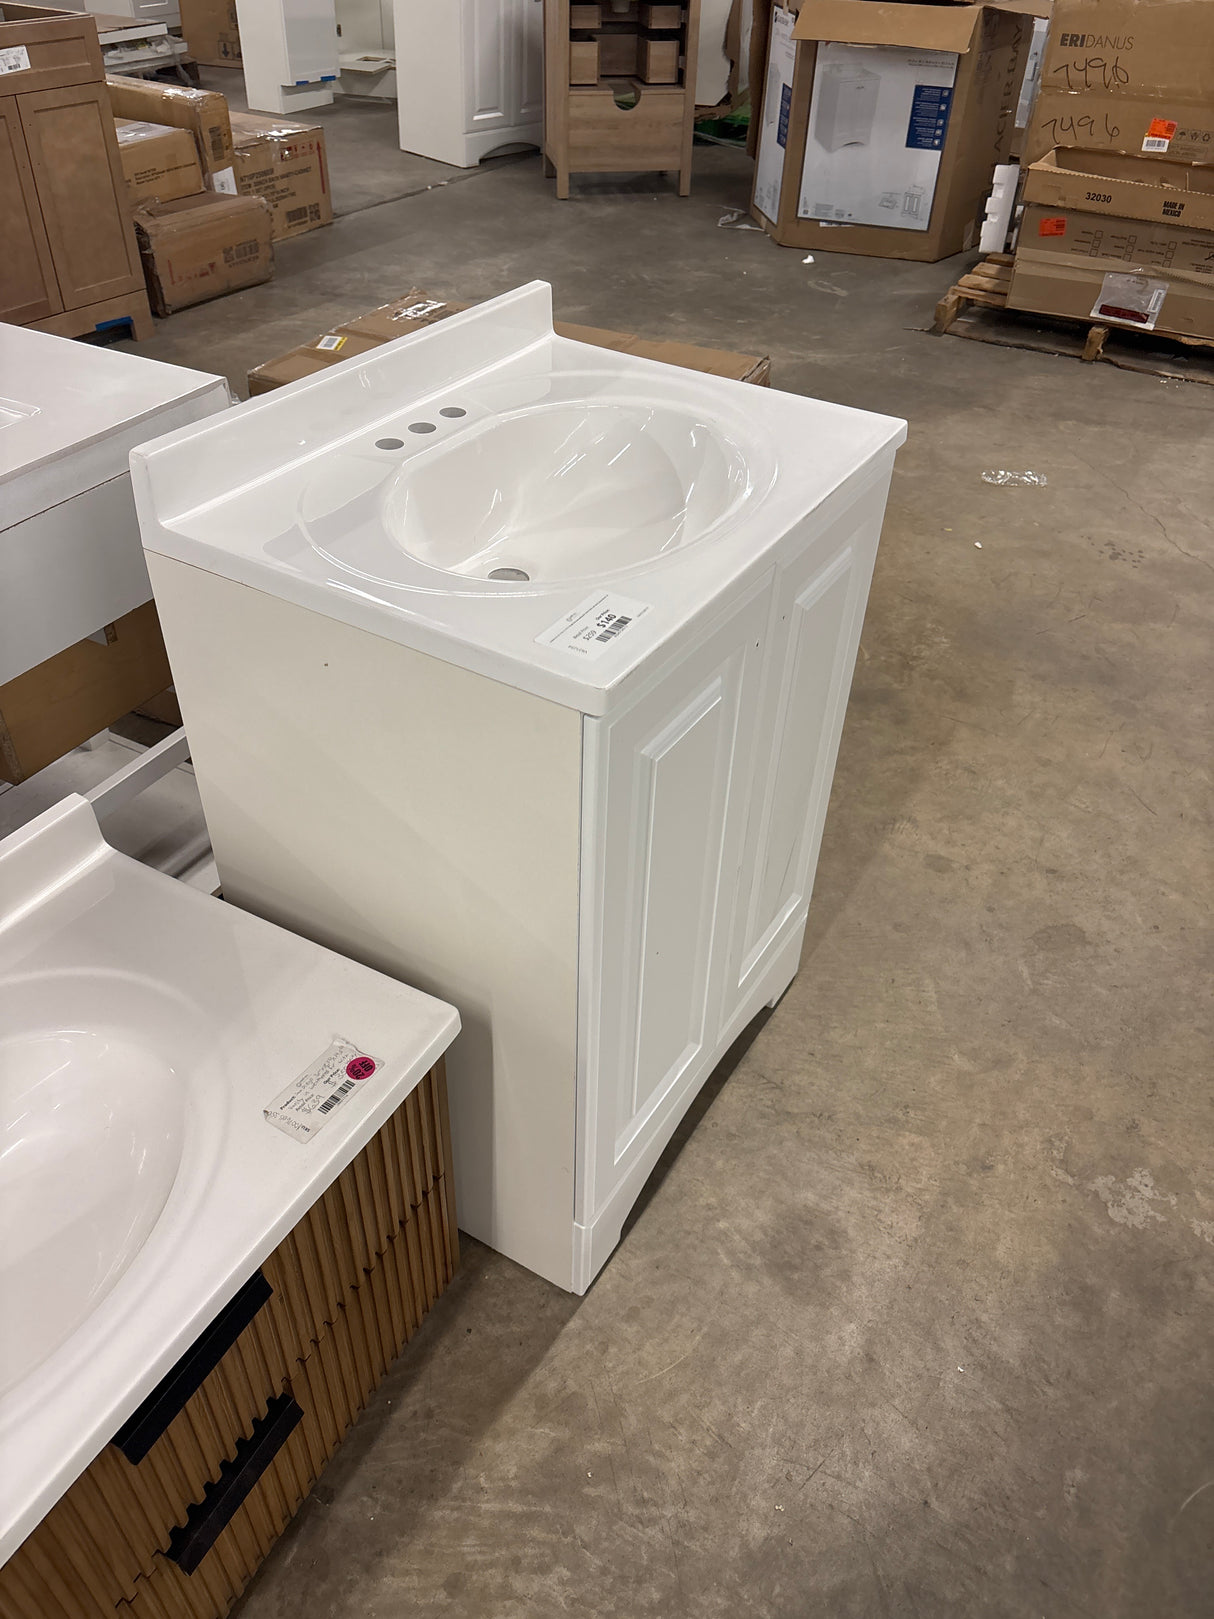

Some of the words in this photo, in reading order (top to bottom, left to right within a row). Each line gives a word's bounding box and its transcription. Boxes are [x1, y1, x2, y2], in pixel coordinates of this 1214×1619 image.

[1060, 32, 1135, 50] ERIDANUS
[1085, 191, 1113, 204] 32030
[1162, 200, 1178, 210] MADE
[1178, 203, 1186, 211] IN
[1161, 208, 1182, 218] MEXICO
[596, 613, 617, 629] $140
[349, 1064, 366, 1080] 20%
[358, 1060, 374, 1072] OFF
